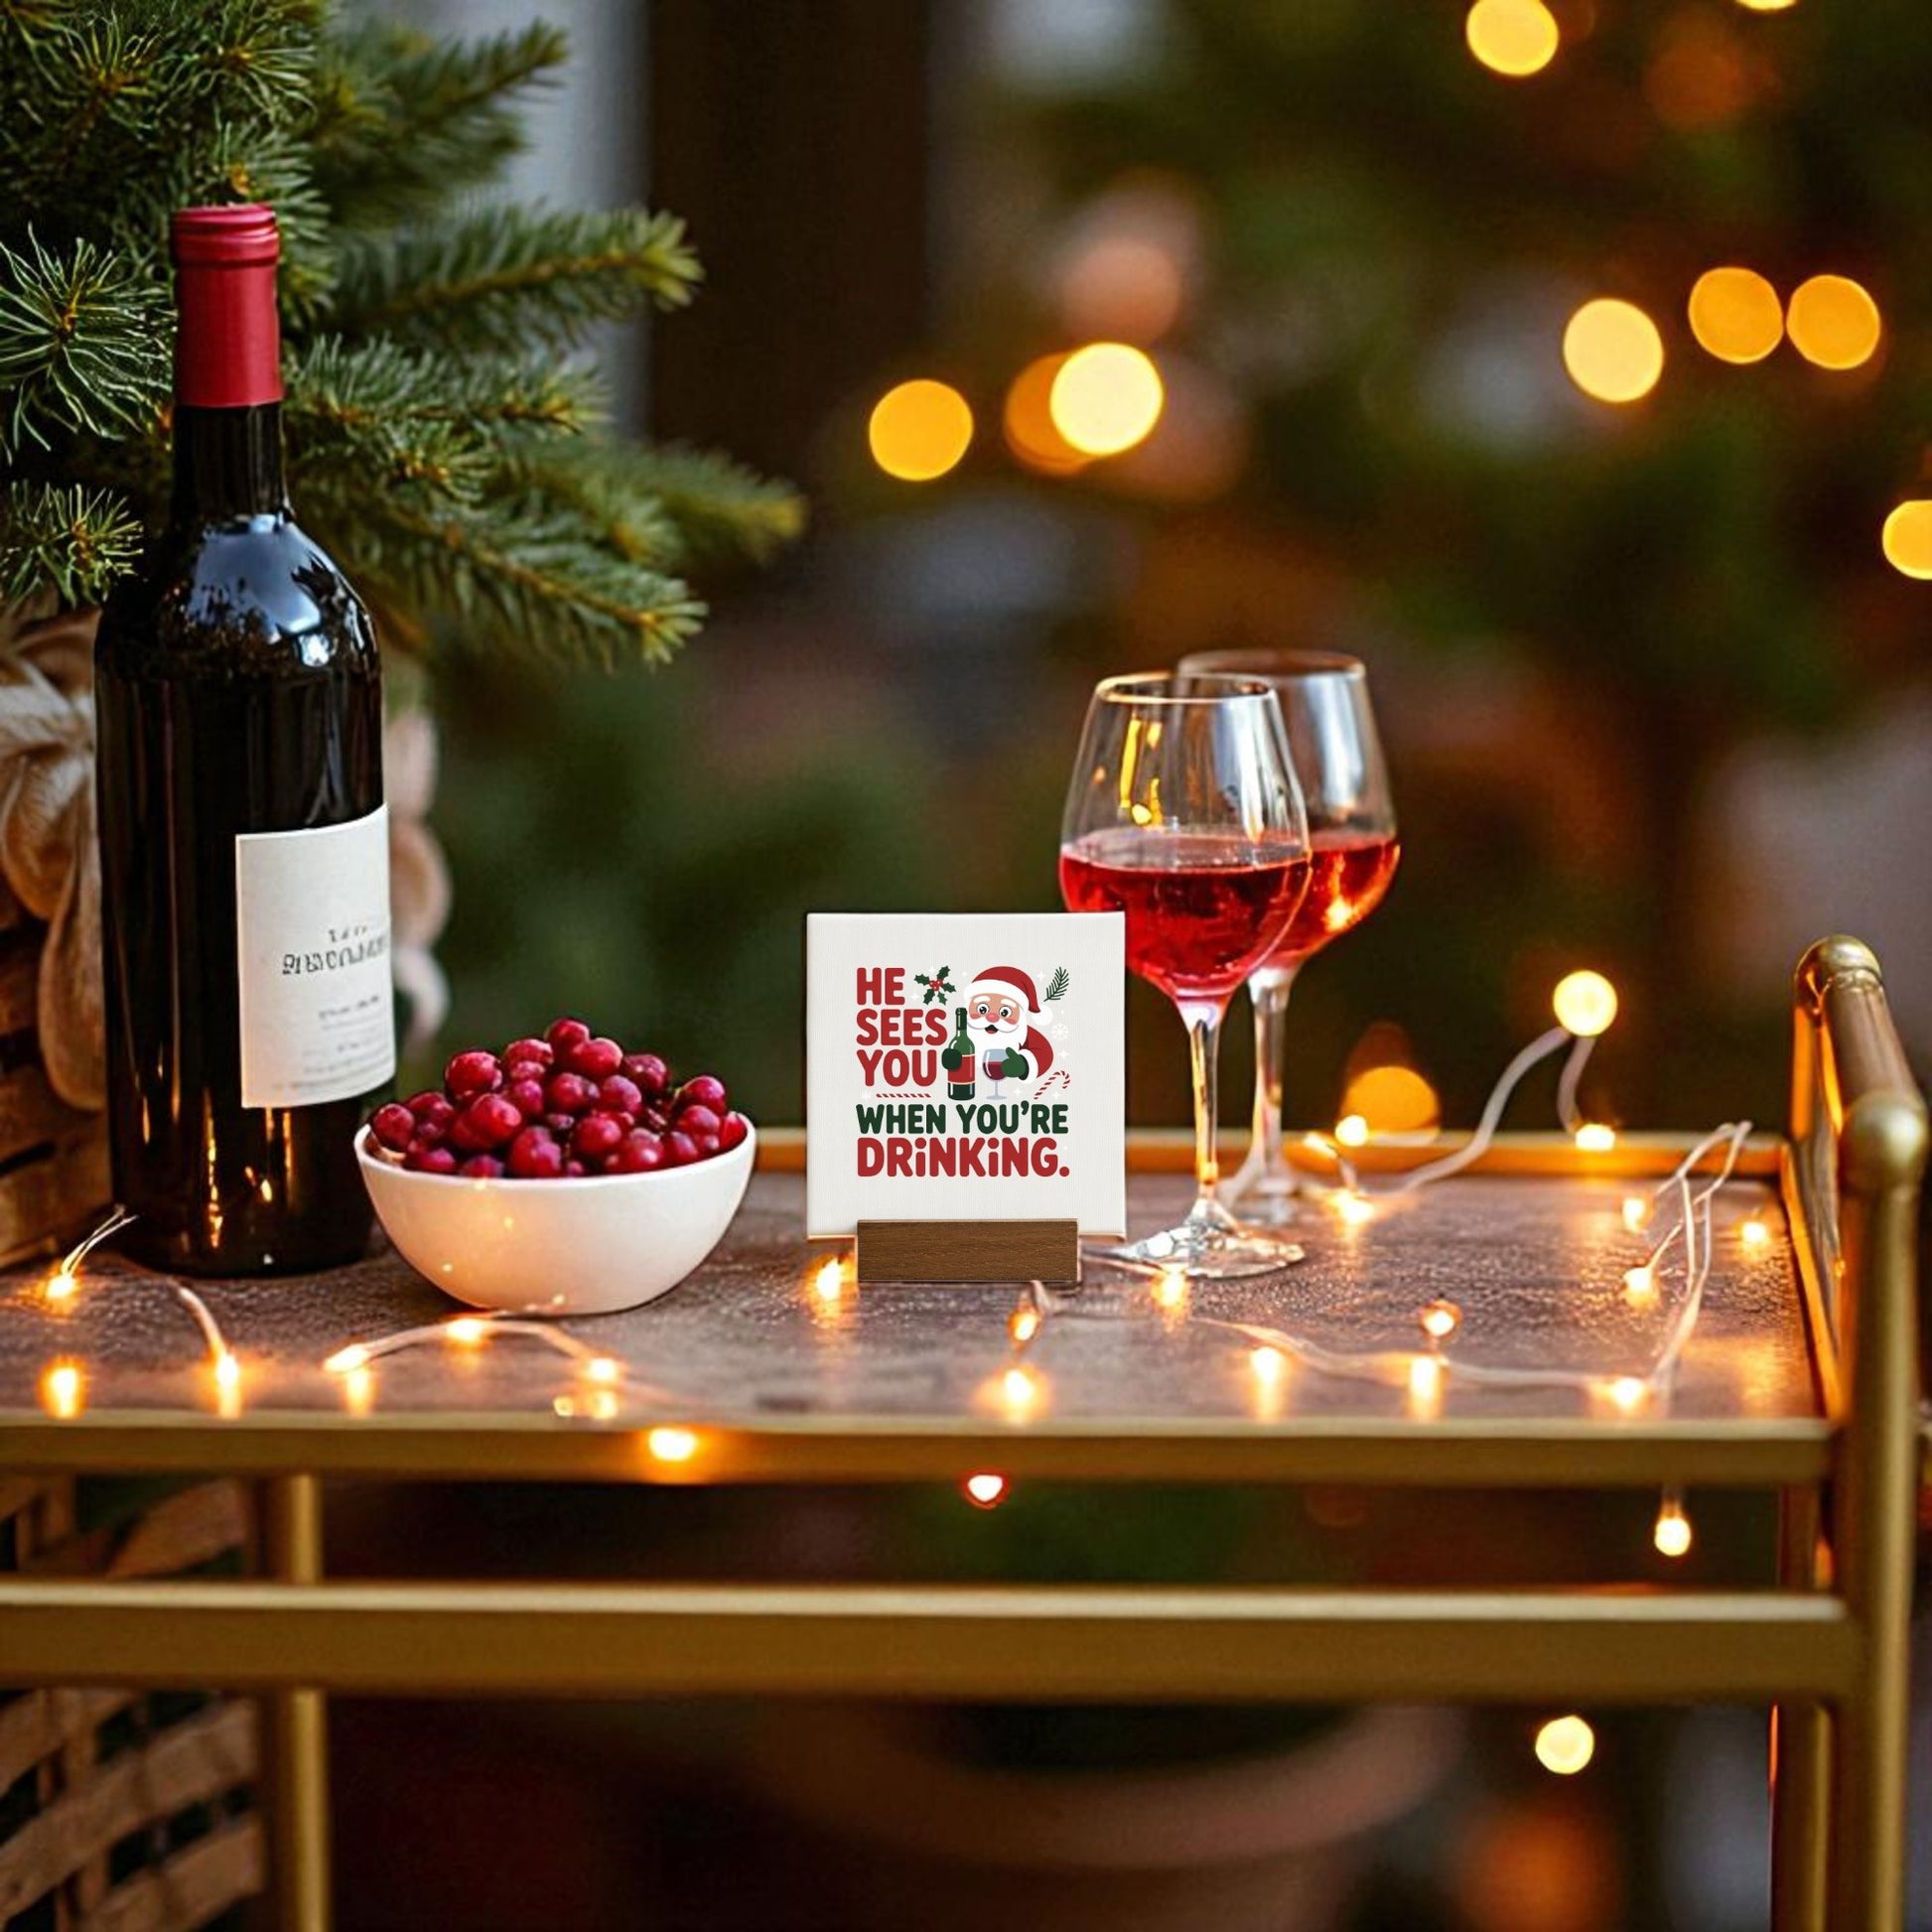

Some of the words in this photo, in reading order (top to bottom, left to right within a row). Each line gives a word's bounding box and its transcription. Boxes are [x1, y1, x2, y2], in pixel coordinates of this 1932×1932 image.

[856, 967, 905, 1006] HE
[856, 1008, 948, 1046] SEES
[856, 1049, 937, 1087] YOU
[856, 1103, 946, 1135] WHEN
[955, 1100, 1069, 1135] YOU’RE
